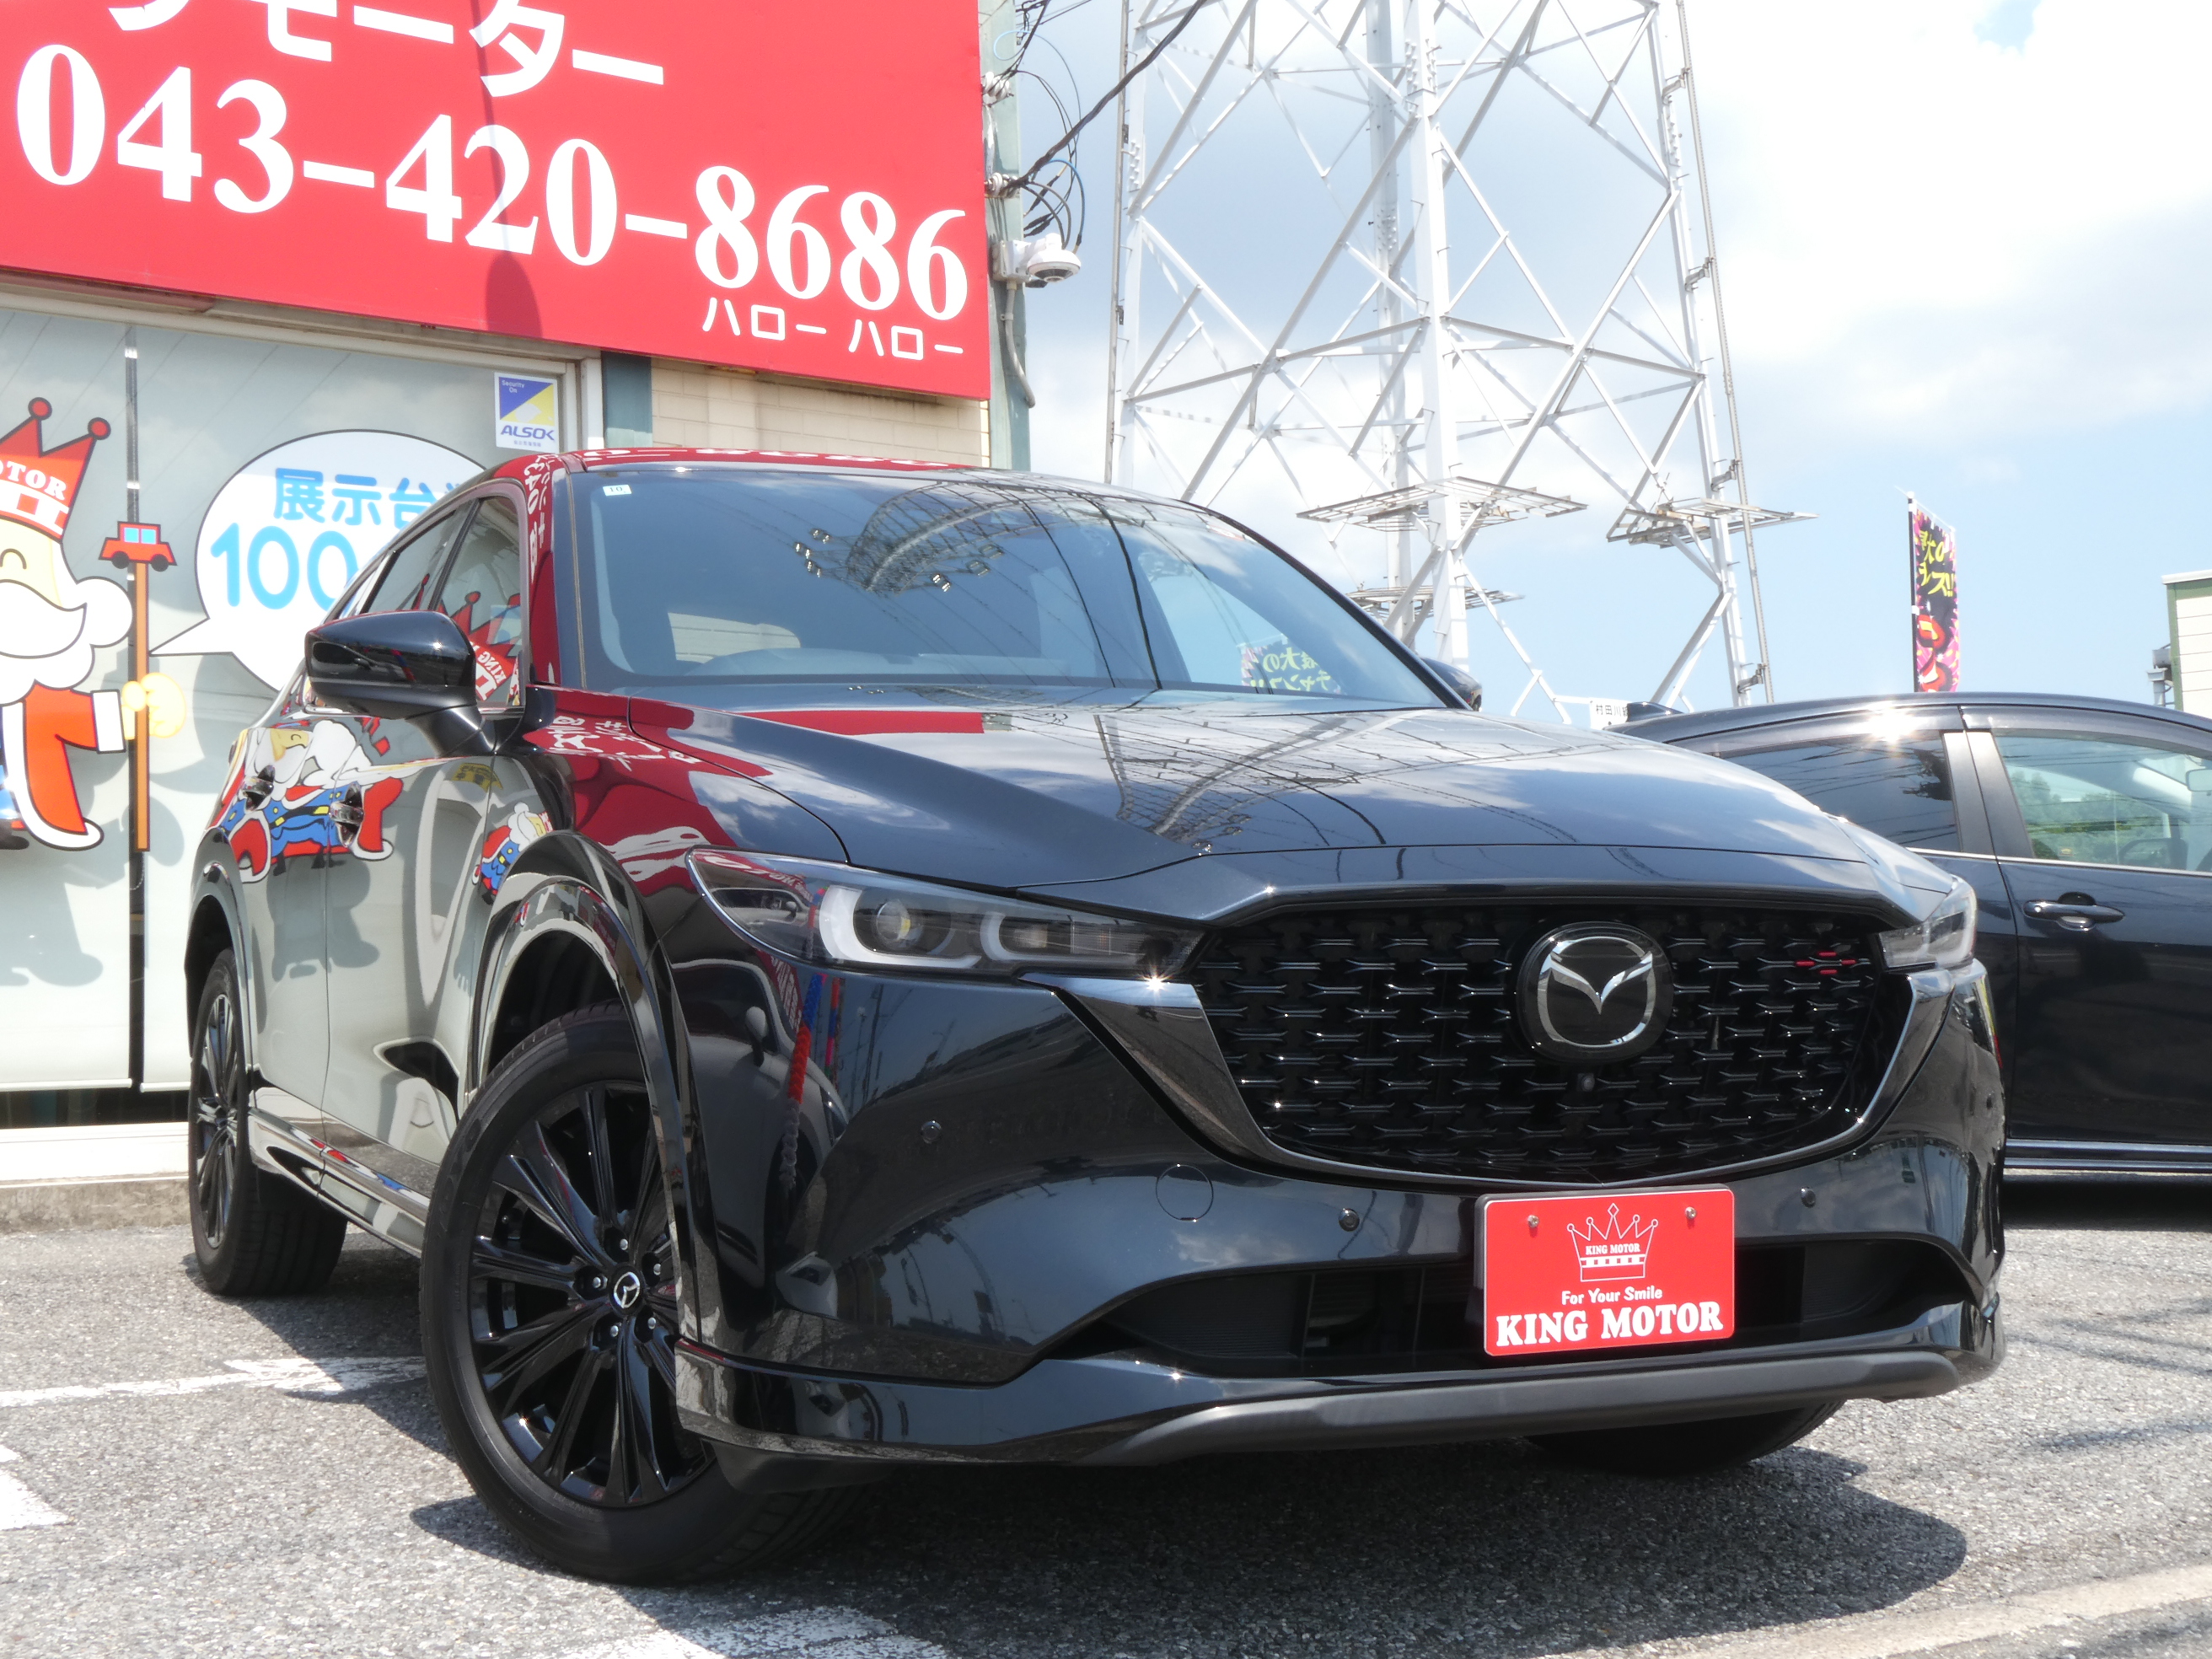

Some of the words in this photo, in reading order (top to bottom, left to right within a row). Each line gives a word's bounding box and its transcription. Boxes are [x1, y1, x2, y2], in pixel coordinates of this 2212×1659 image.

[17, 44, 968, 321] 043-420-8686
[702, 297, 827, 341] ハロー
[848, 319, 964, 361] ハロー
[502, 379, 525, 389] Security
[501, 425, 555, 441] ALSOK
[273, 468, 465, 530] 展示台
[1585, 1244, 1608, 1255] KING
[1609, 1243, 1641, 1254] MOTOR
[1561, 1290, 1585, 1306] For
[1588, 1287, 1621, 1304] Your
[1624, 1285, 1663, 1302] Smile
[1495, 1310, 1589, 1347] KING
[1600, 1301, 1724, 1340] MOTOR
